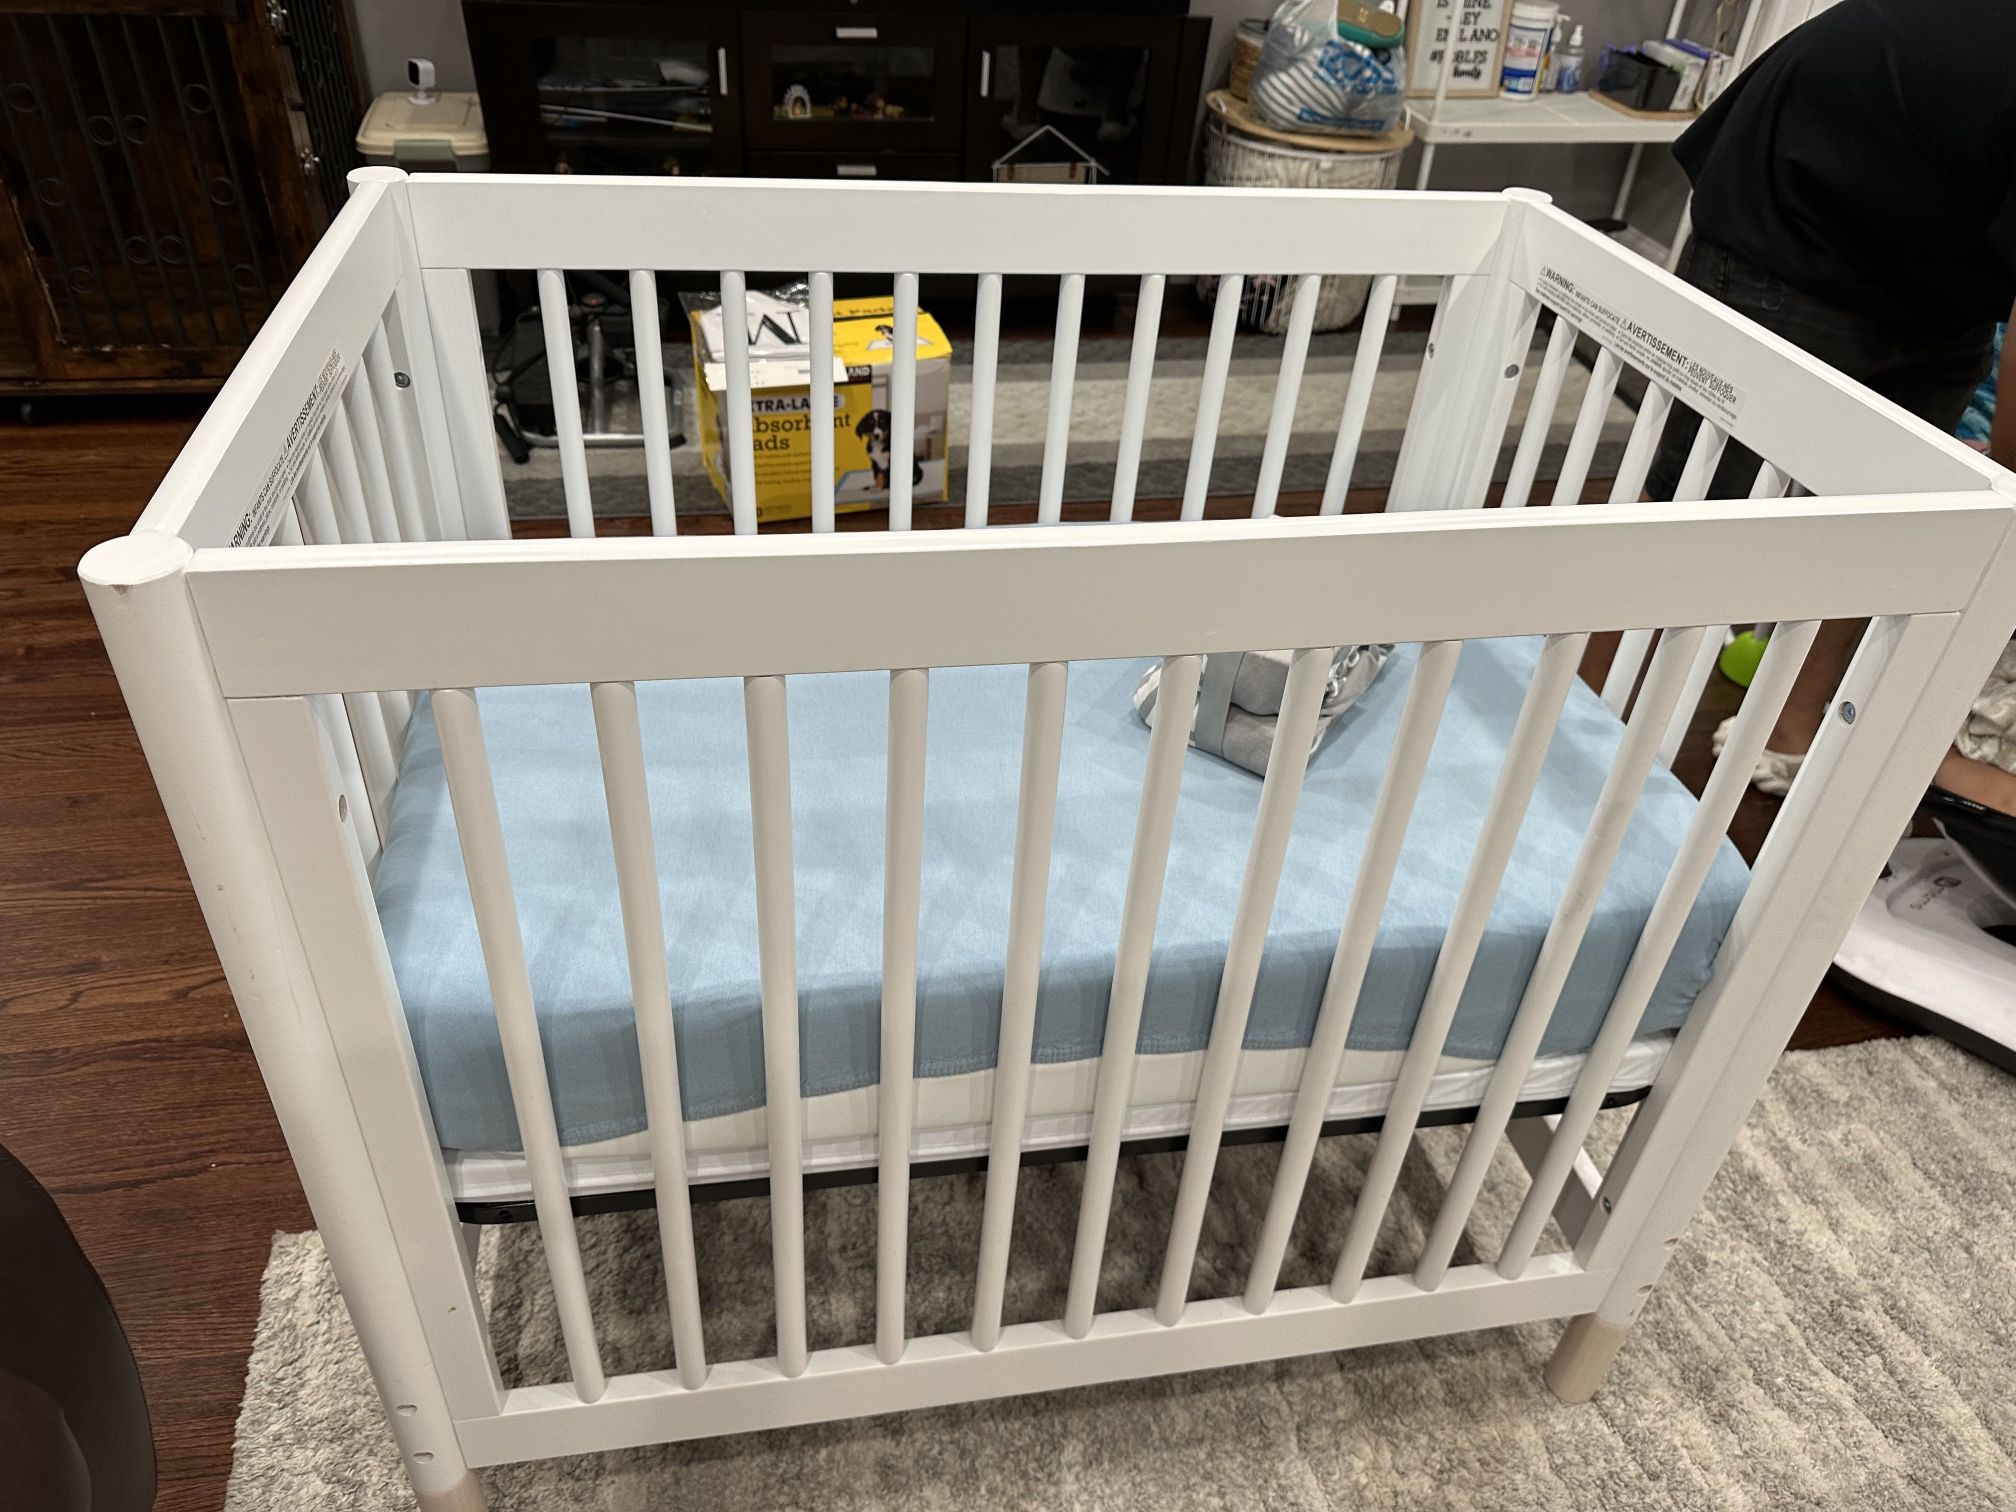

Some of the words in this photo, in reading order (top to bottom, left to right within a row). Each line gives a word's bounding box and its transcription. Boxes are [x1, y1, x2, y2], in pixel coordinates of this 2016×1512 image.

[1546, 266, 1575, 294] WARNING:
[1627, 321, 1689, 370] AVERTISSEMENT:
[753, 414, 850, 433] bsorbnt
[754, 434, 790, 451] ads
[229, 512, 252, 548] ARNING:
